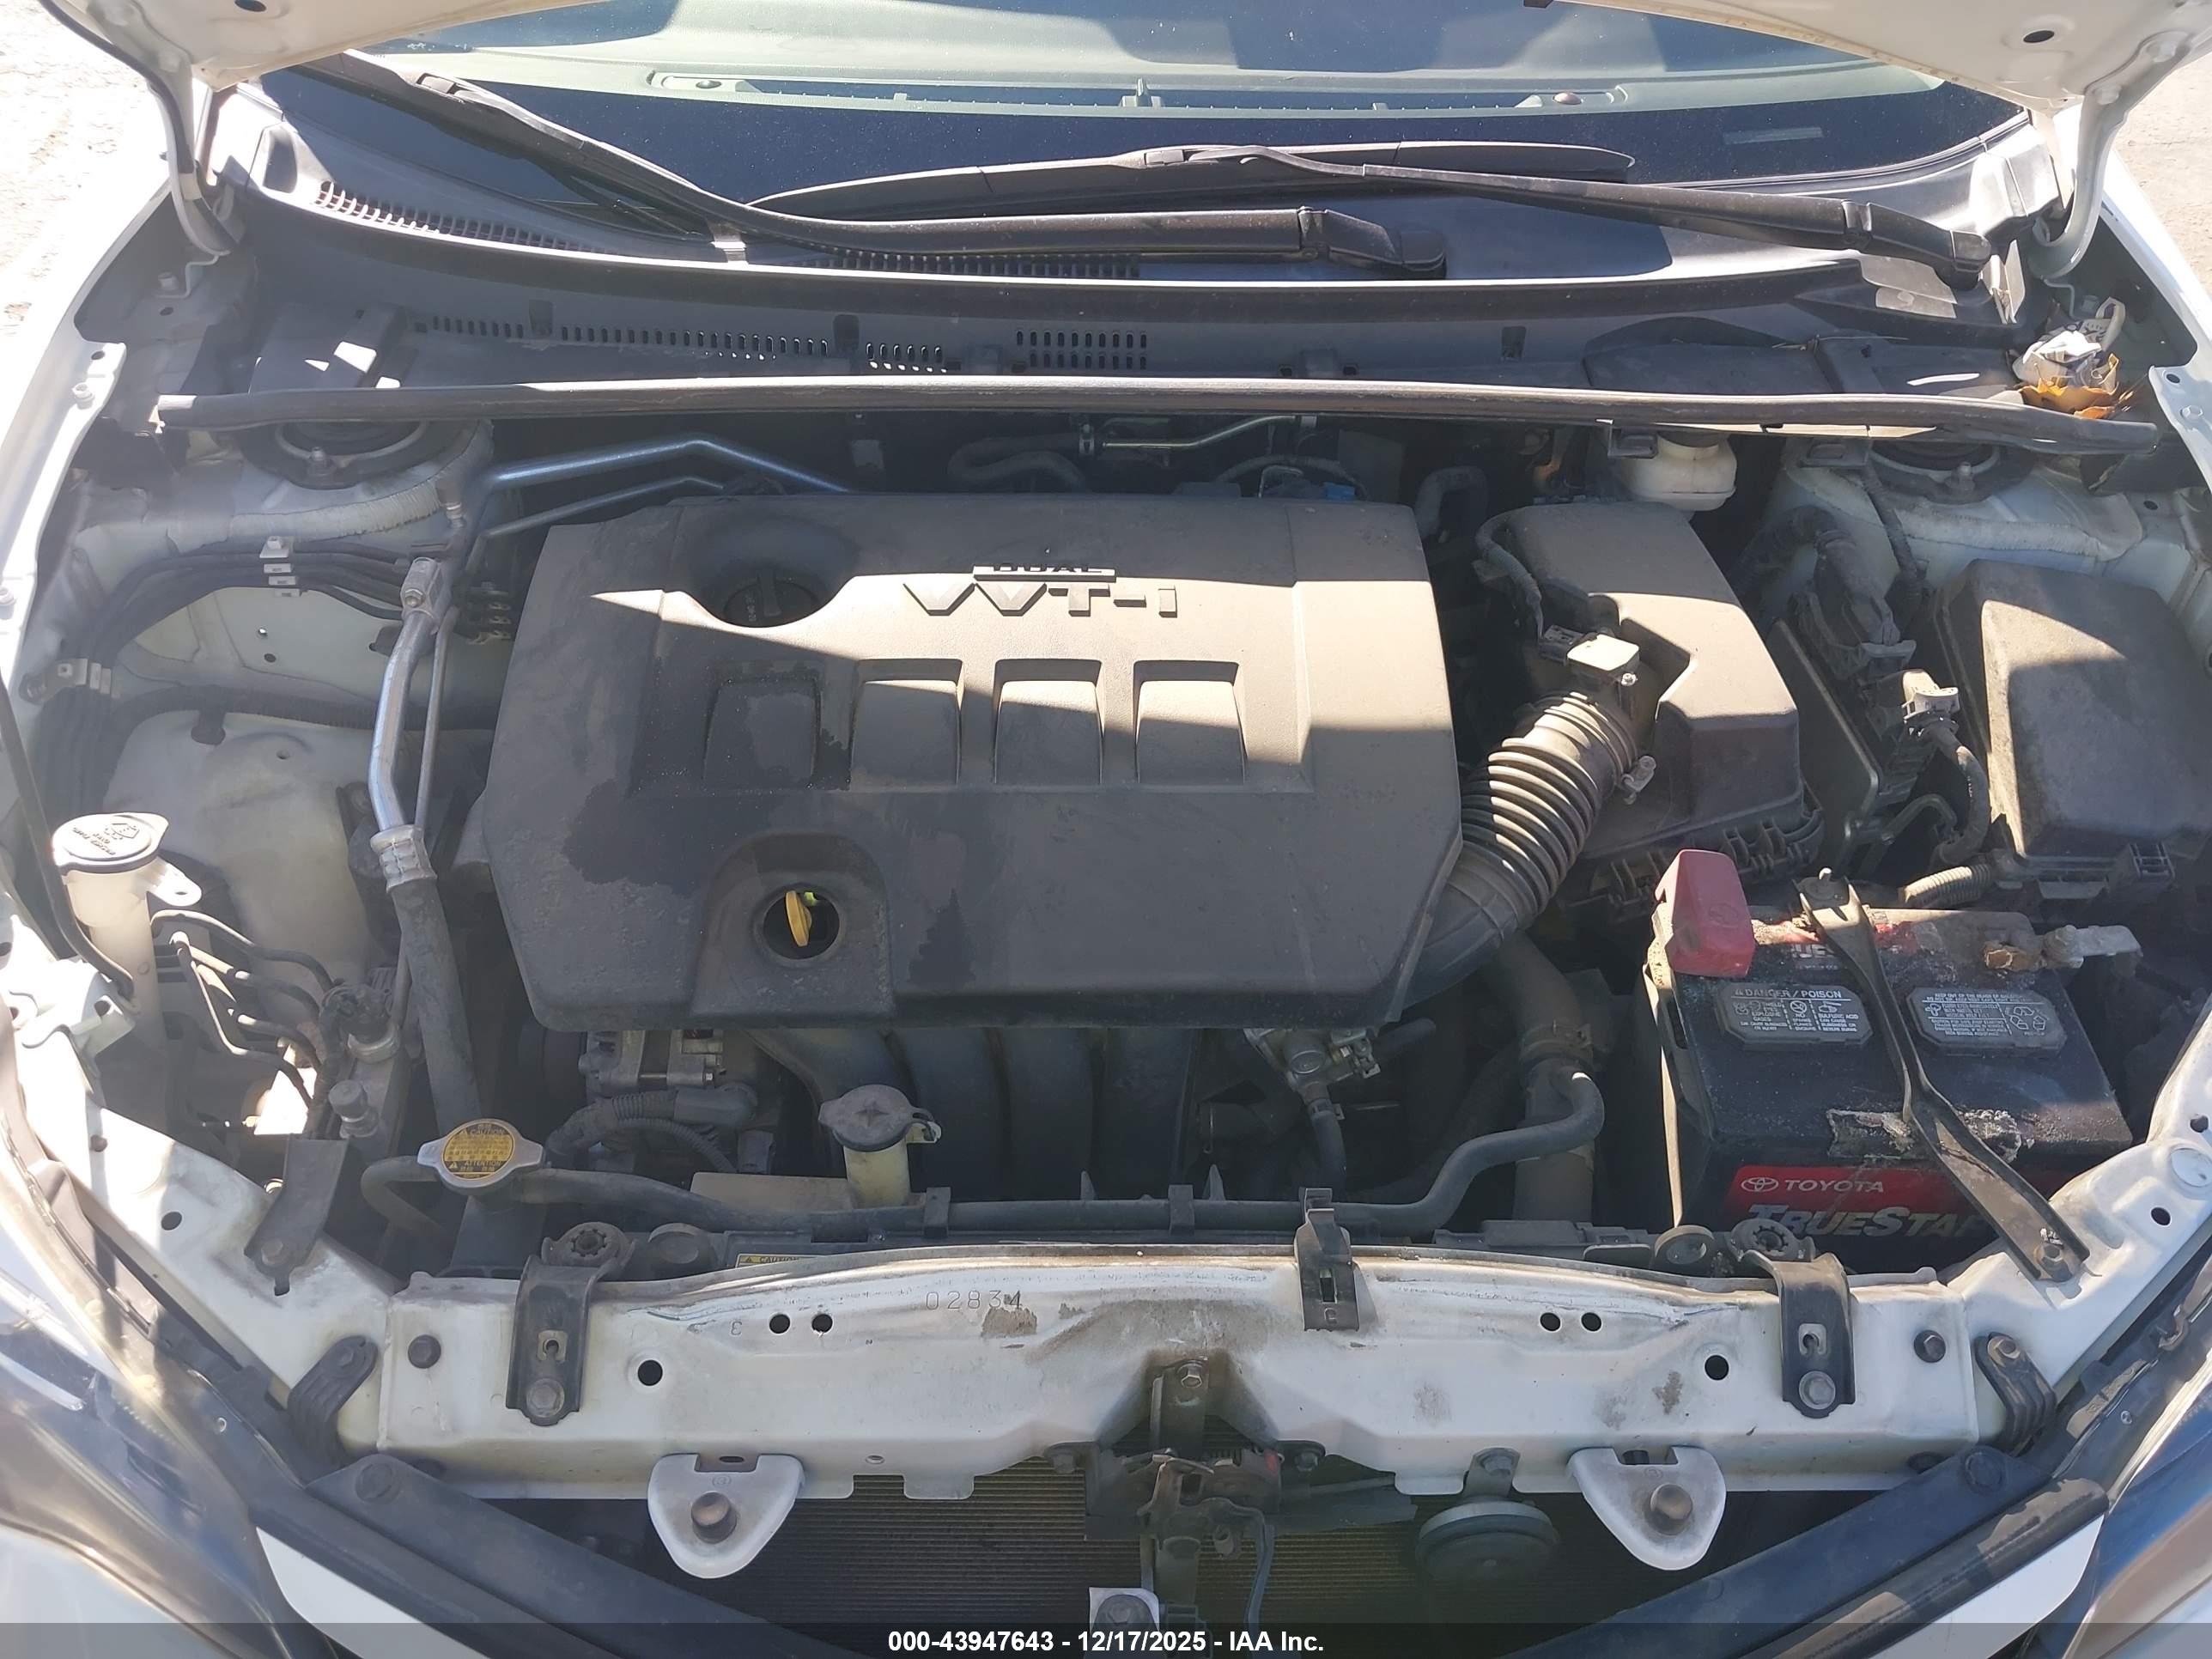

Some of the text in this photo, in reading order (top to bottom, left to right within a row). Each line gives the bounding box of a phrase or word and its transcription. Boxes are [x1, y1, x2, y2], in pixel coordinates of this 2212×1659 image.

[1746, 988, 1791, 999] DANGER
[1802, 989, 1842, 999] POISON
[1784, 1179, 1885, 1193] TOYOTA
[926, 1290, 1022, 1310] 02834
